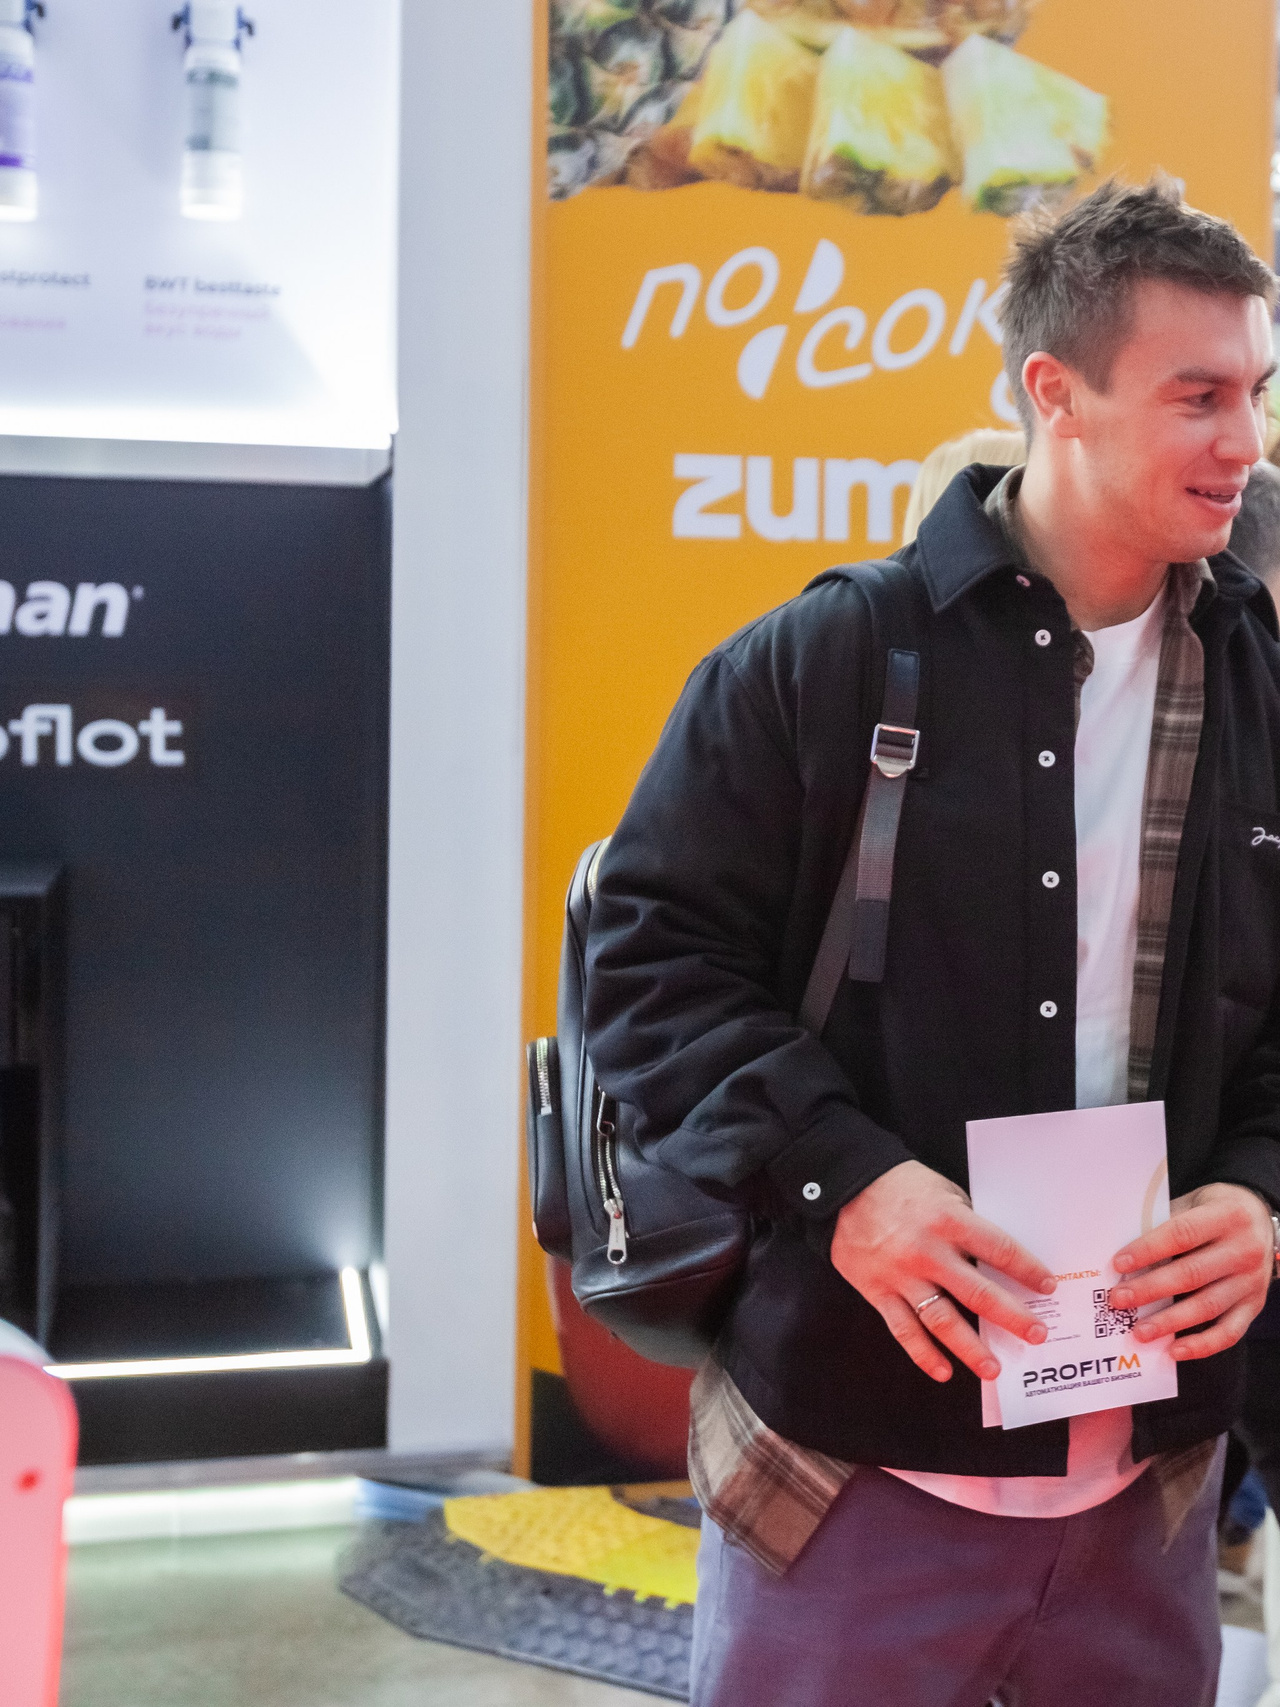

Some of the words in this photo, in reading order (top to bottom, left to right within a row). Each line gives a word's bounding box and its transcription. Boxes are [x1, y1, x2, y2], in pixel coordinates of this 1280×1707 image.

[0, 703, 185, 767] flot
[1023, 1353, 1141, 1388] PROFITM
[1025, 1381, 1082, 1398] АВТОМАТИЗАЦИЯ
[1082, 1376, 1110, 1387] ВАШЕГО
[1110, 1371, 1142, 1383] БИЗНЕСА
